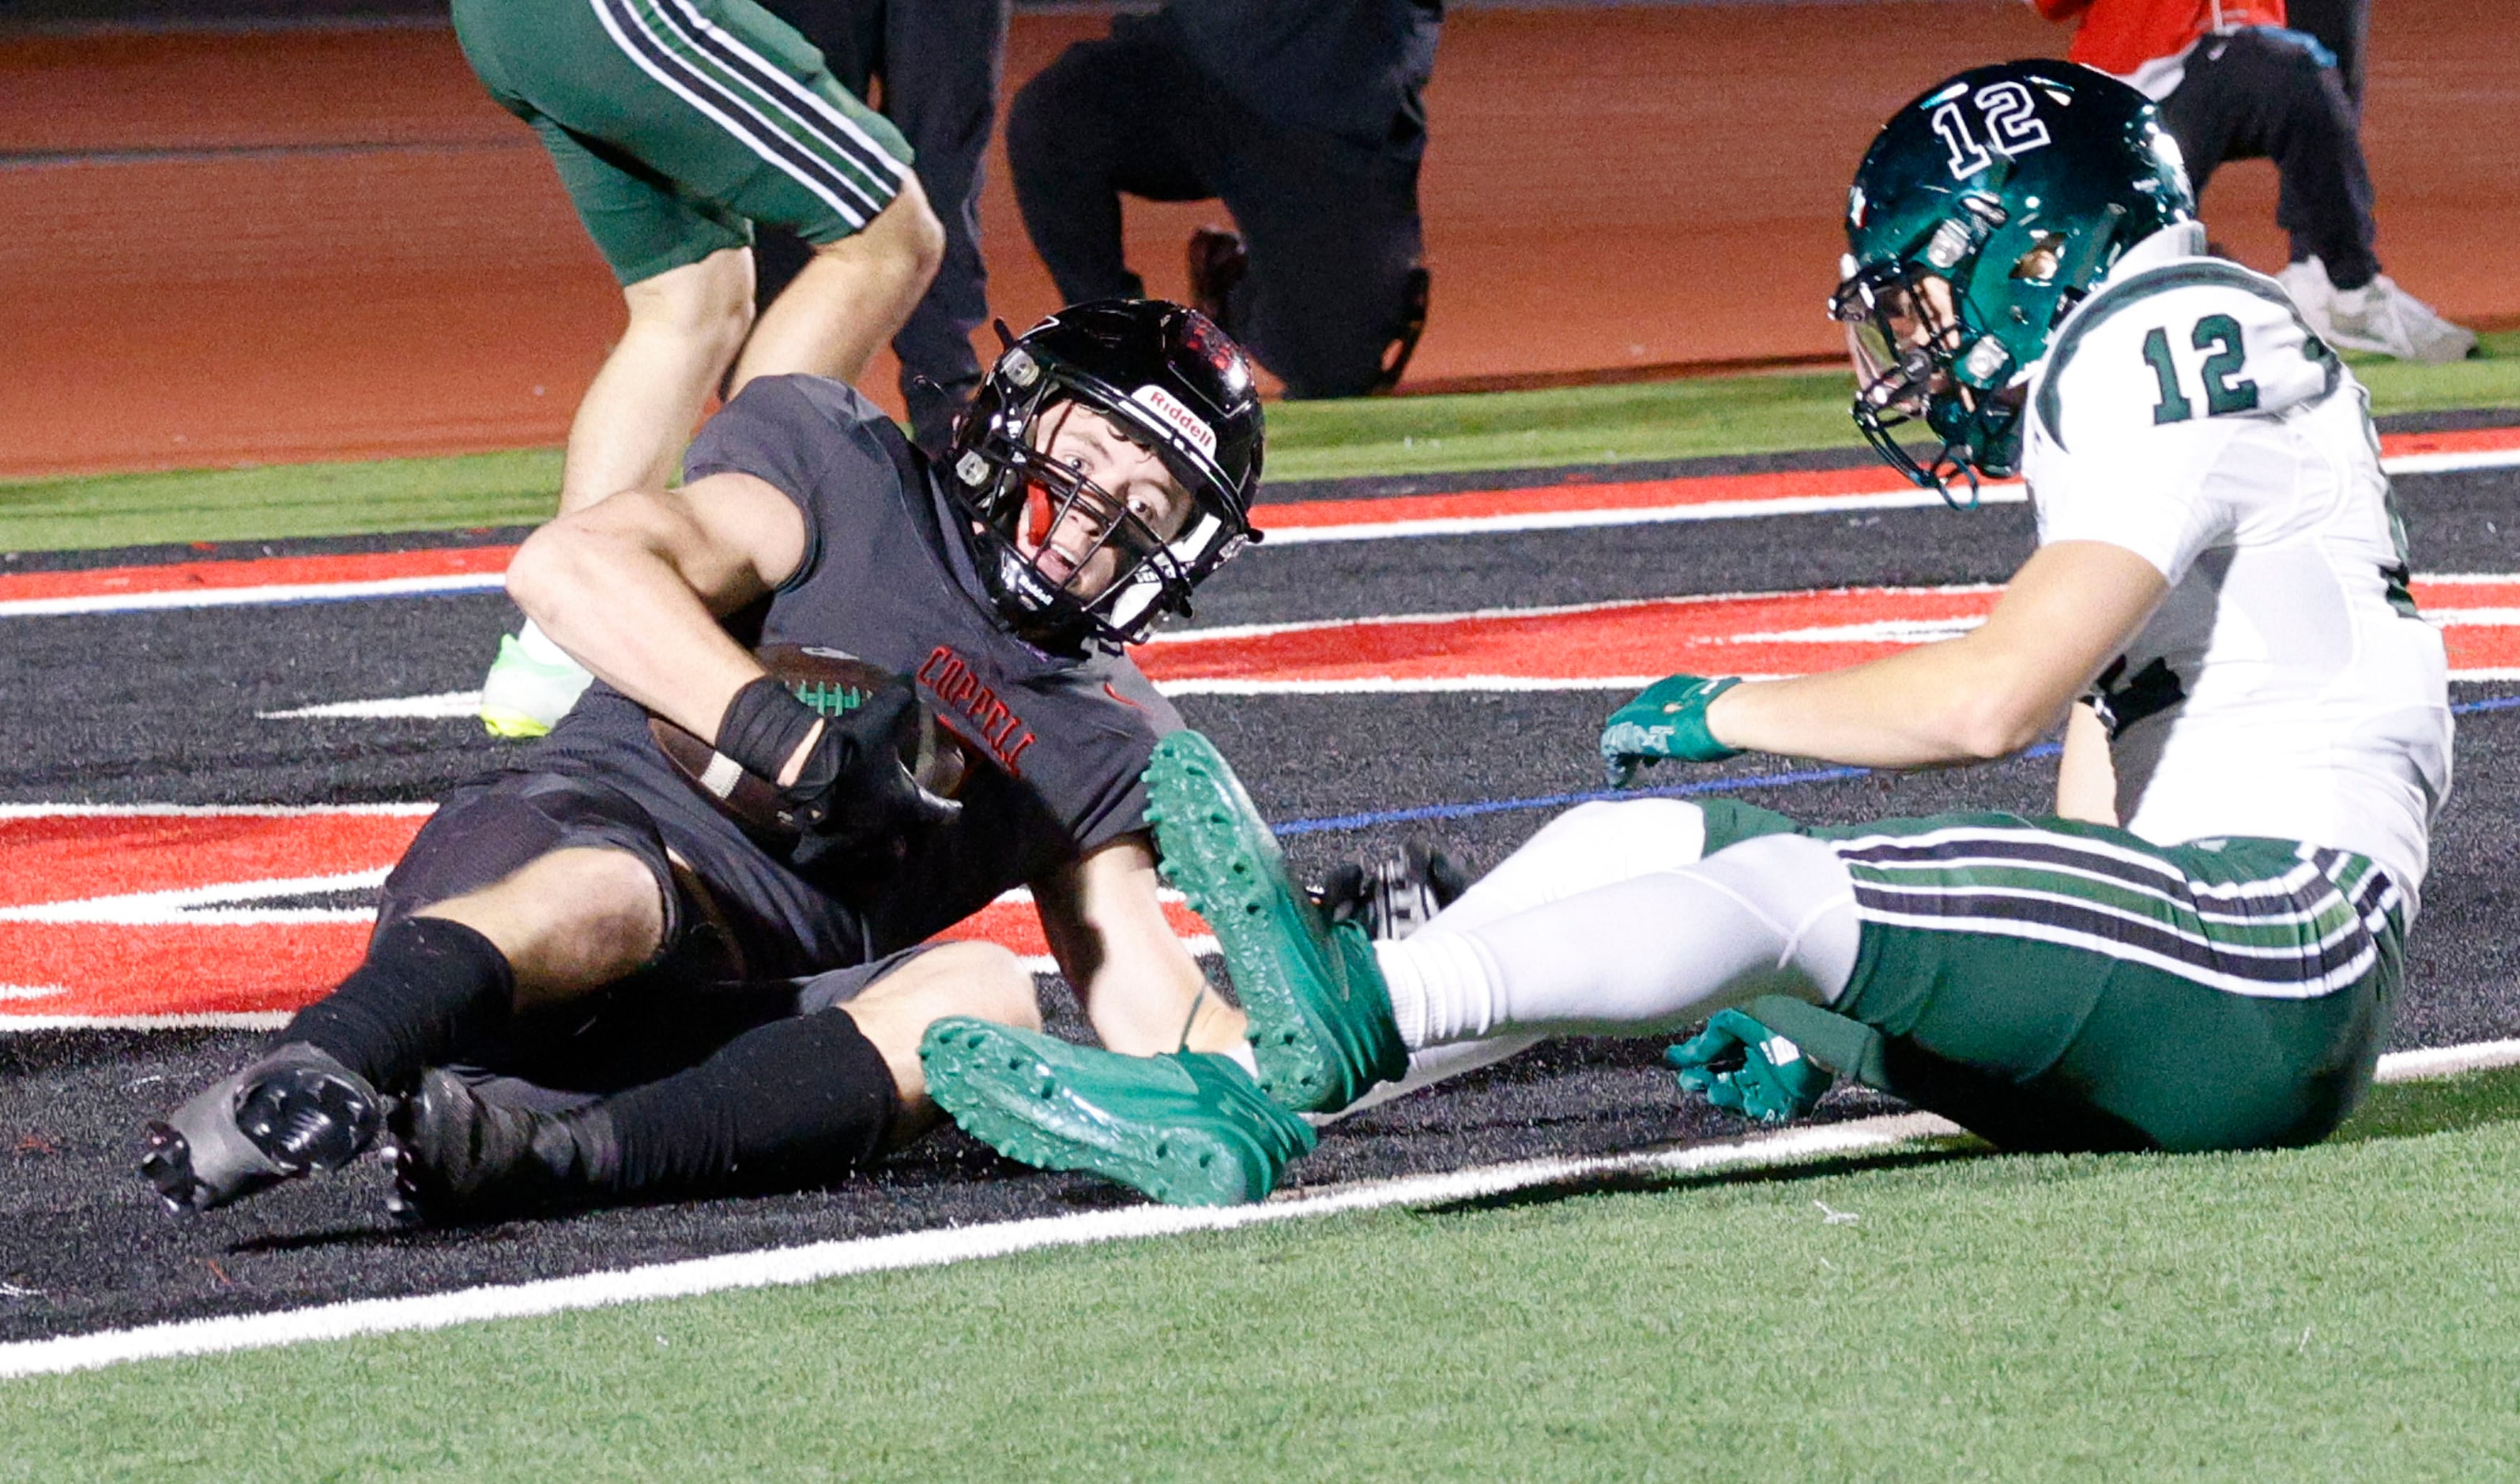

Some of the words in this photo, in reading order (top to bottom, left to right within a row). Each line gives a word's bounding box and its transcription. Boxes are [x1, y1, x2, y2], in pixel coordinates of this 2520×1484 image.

[1932, 81, 2052, 181] 12
[1150, 391, 1212, 446] Riddell
[2142, 313, 2259, 425] 12
[917, 645, 1037, 779] COPPELL
